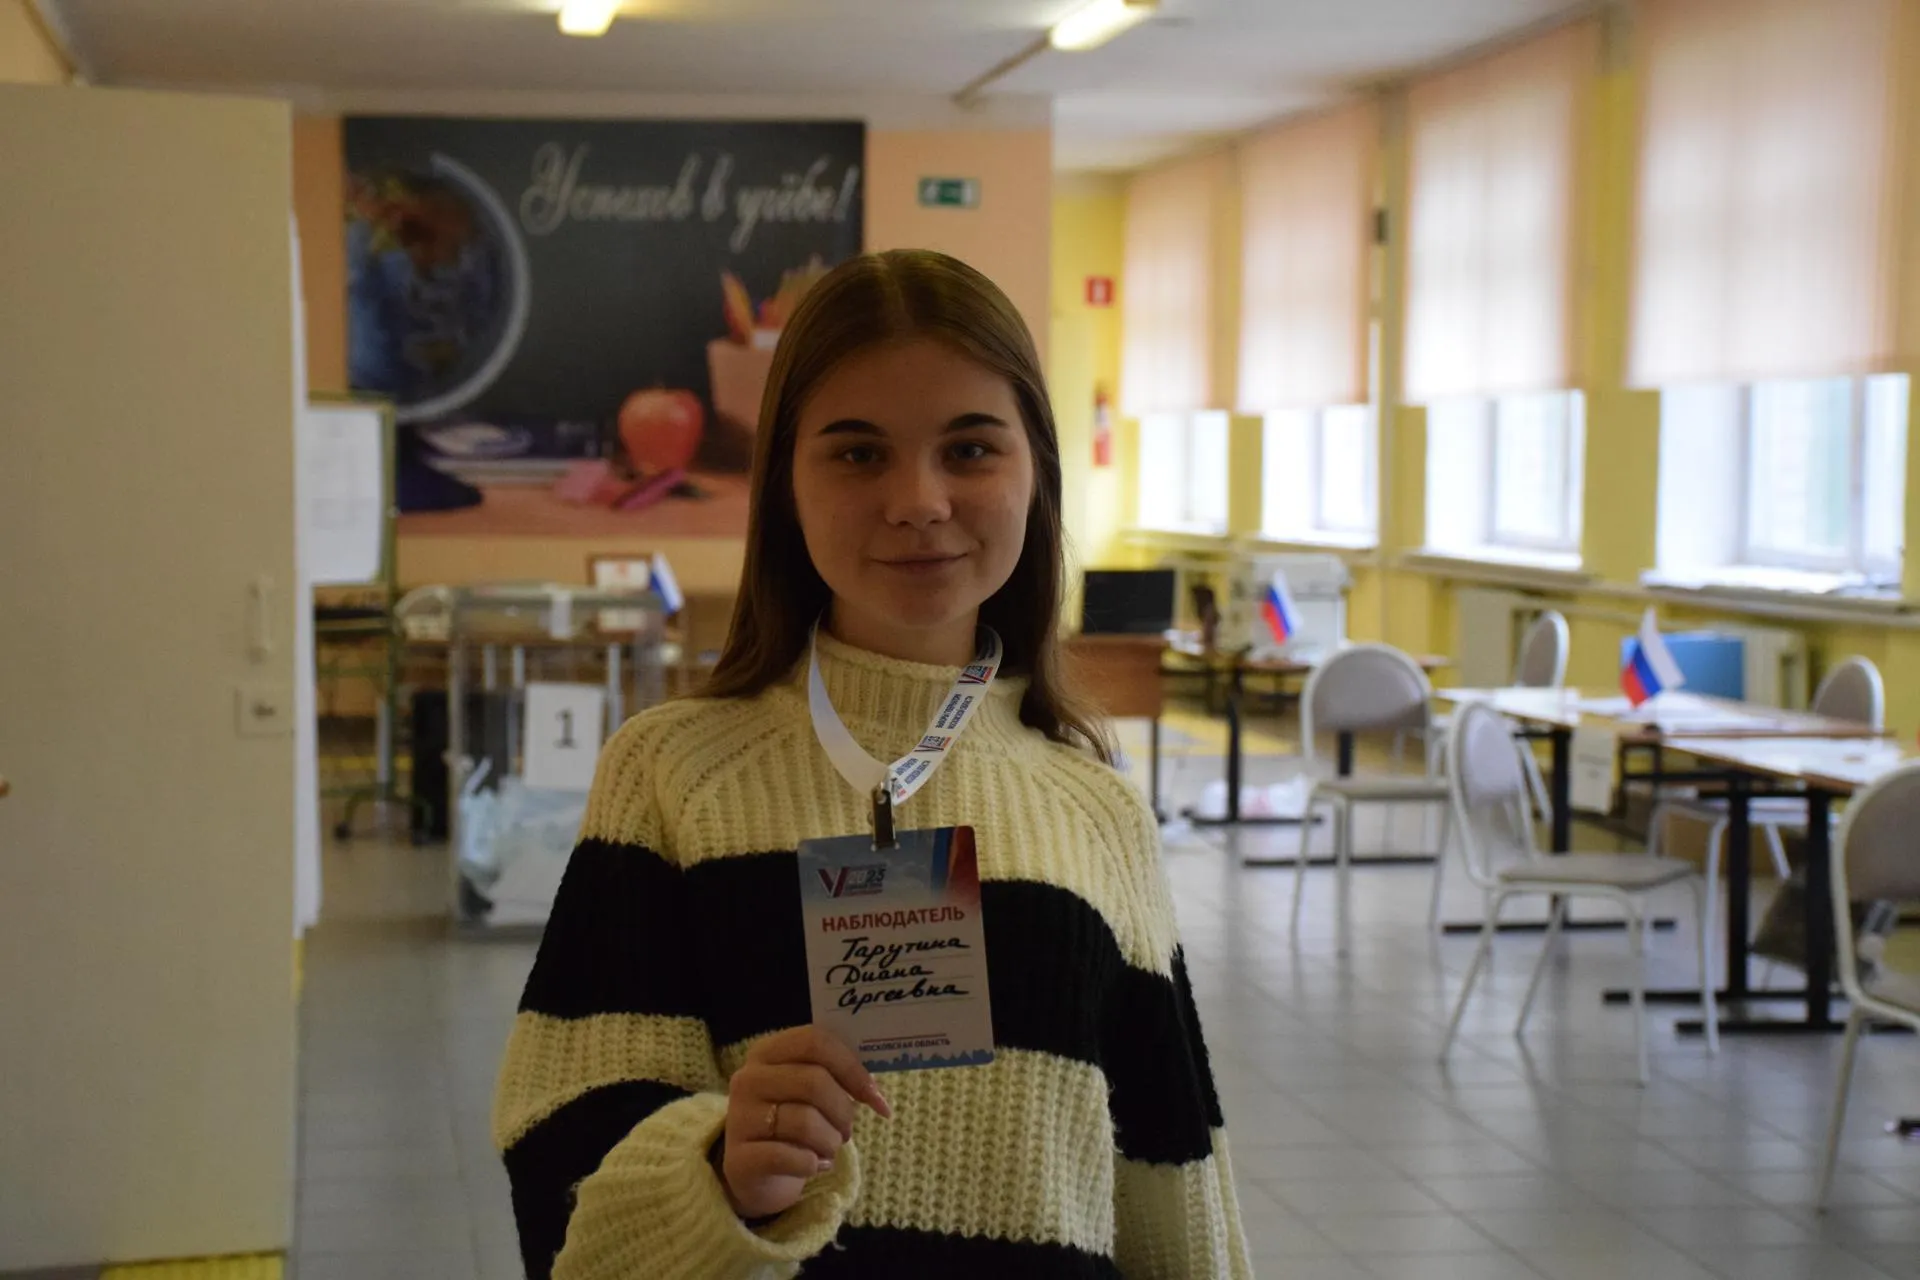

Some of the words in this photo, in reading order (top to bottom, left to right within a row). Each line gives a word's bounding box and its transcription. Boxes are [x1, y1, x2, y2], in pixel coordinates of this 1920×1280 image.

[519, 142, 700, 236] Успехов
[702, 152, 734, 223] в
[552, 707, 581, 750] 1
[822, 906, 965, 932] НАБЛЮДАТЕЛЬ
[842, 936, 970, 969] Тарутина
[826, 964, 934, 986] Диана
[838, 977, 969, 1015] Сергеевна
[859, 1039, 914, 1051] МОСКОВСКАЯ
[914, 1037, 950, 1048] ОБЛАСТЬ
